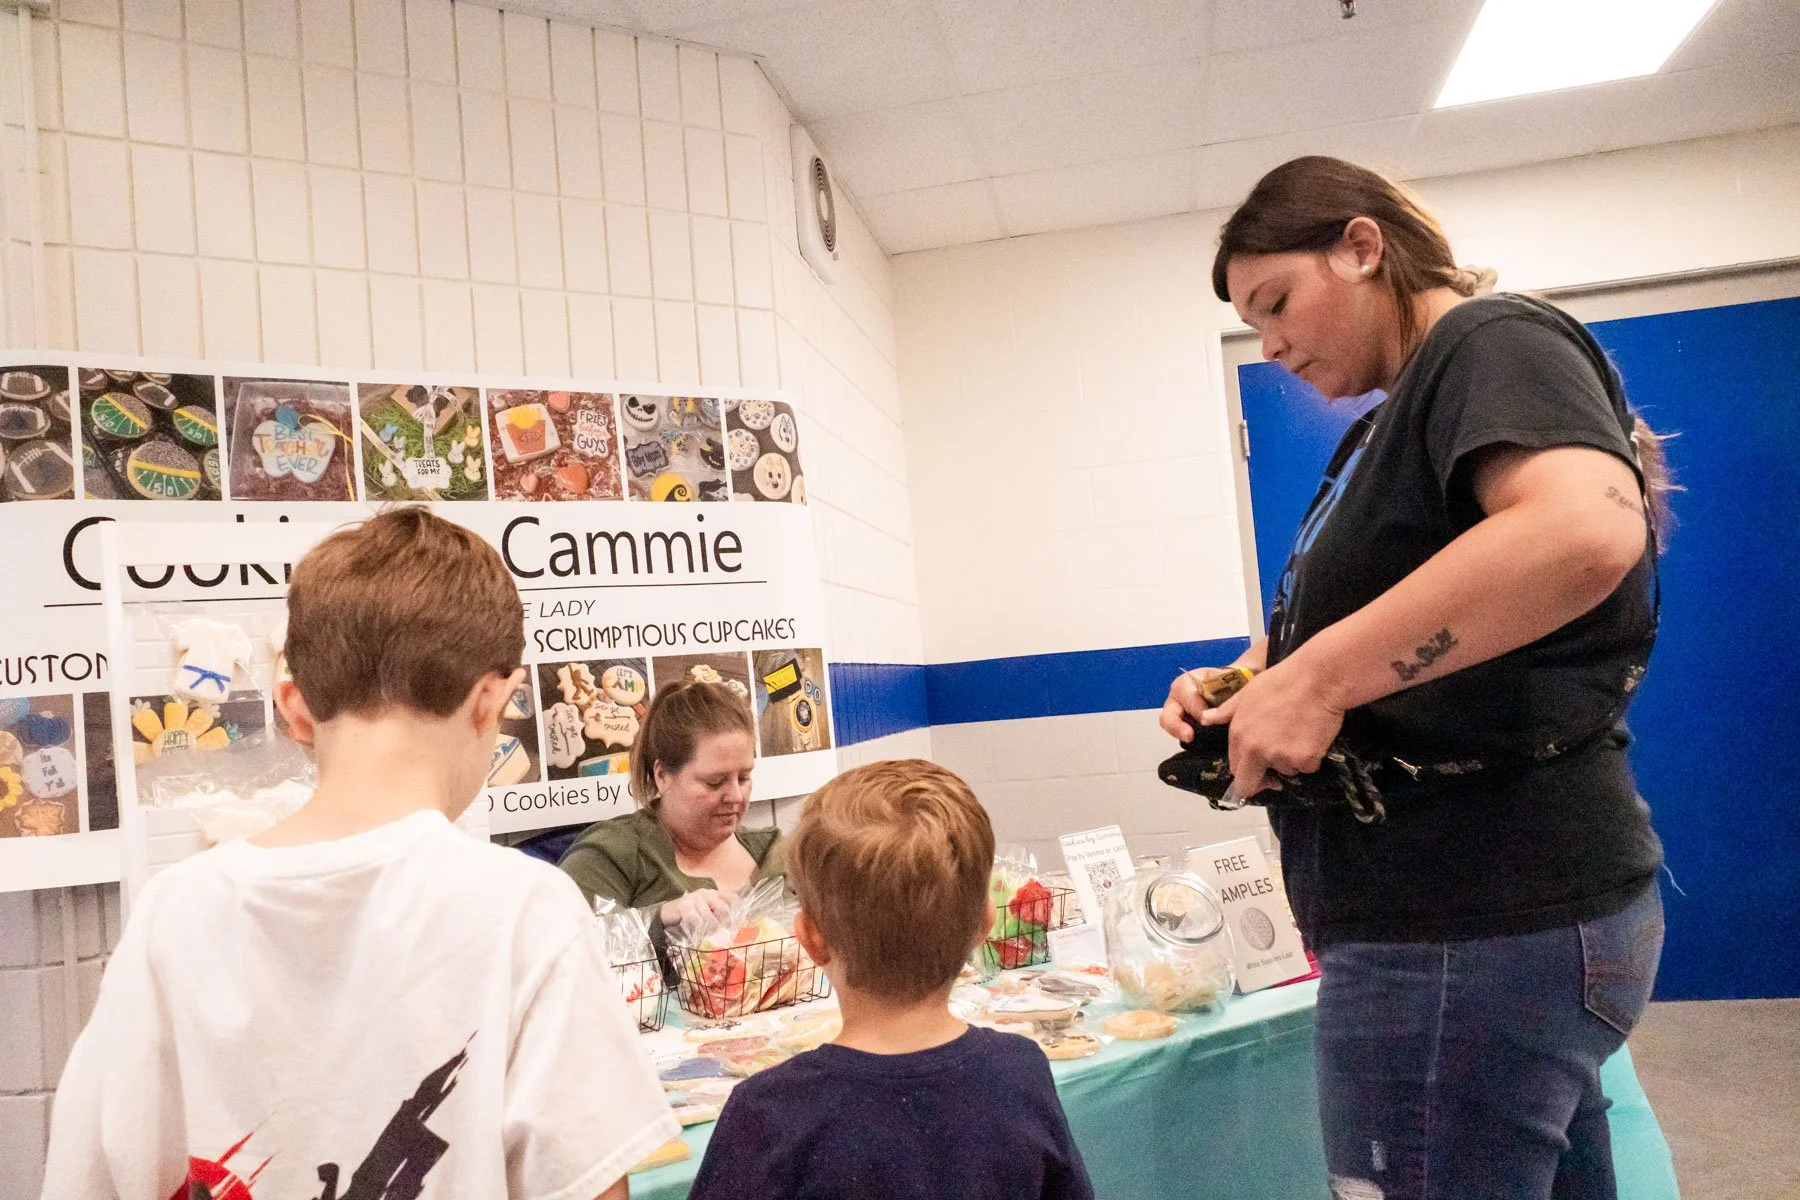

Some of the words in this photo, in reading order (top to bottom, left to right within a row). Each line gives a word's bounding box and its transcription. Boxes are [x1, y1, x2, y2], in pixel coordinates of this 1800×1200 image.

[580, 411, 607, 427] FRIES
[577, 433, 606, 454] GUYS
[276, 455, 318, 475] EVER
[152, 482, 174, 496] 50
[502, 514, 743, 579] Cammie
[540, 600, 596, 618] LADY
[534, 622, 687, 653] SCRUMPTIOUS
[692, 617, 797, 645] CUPCAKES
[0, 652, 109, 686] USTO
[504, 786, 590, 813] Cookies
[597, 781, 621, 805] by
[1214, 854, 1250, 875] FREE
[1216, 877, 1274, 904] AMPLES
